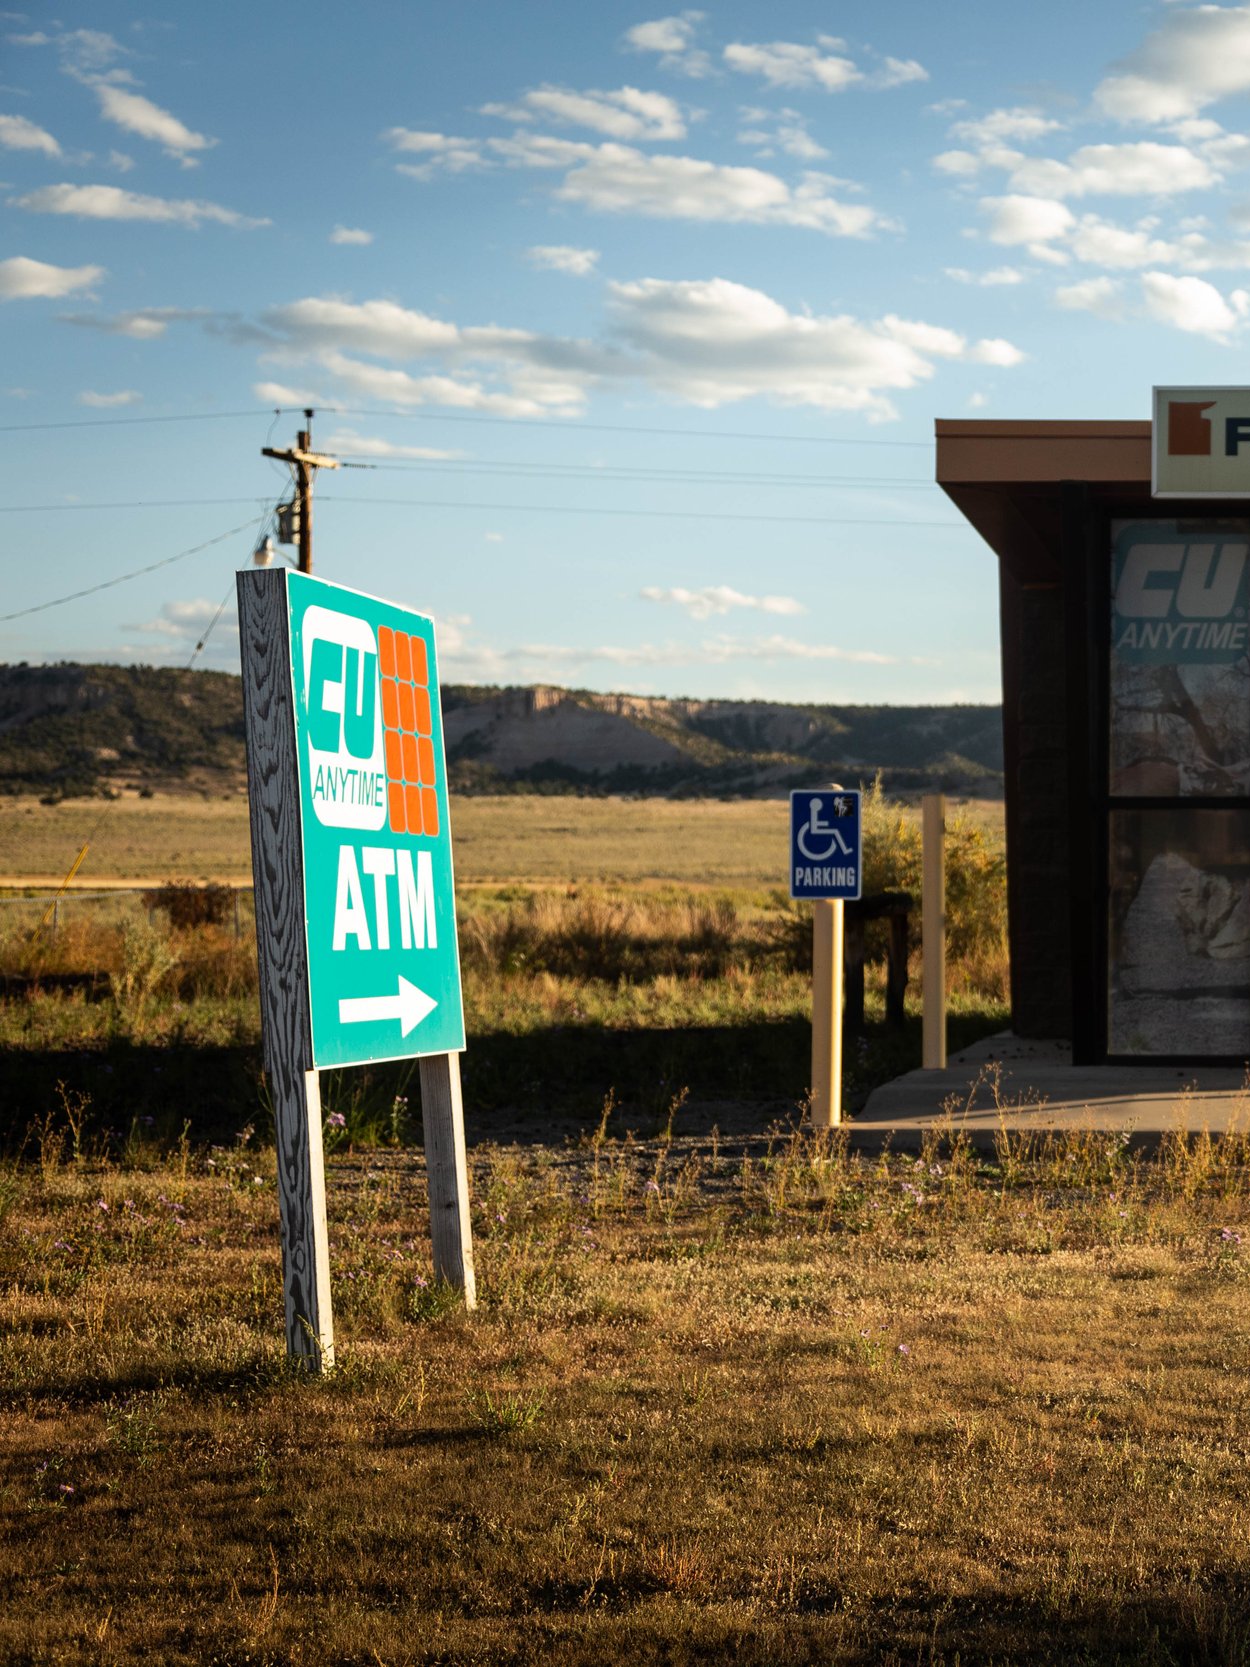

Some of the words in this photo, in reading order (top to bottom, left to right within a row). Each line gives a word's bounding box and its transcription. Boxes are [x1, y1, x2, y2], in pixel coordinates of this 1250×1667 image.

[1115, 543, 1249, 618] CU
[1115, 622, 1249, 649] ANYTIME
[307, 637, 377, 760] CU
[312, 764, 384, 808] ANYTIME
[332, 845, 438, 952] ATM
[795, 867, 855, 887] PARKING
